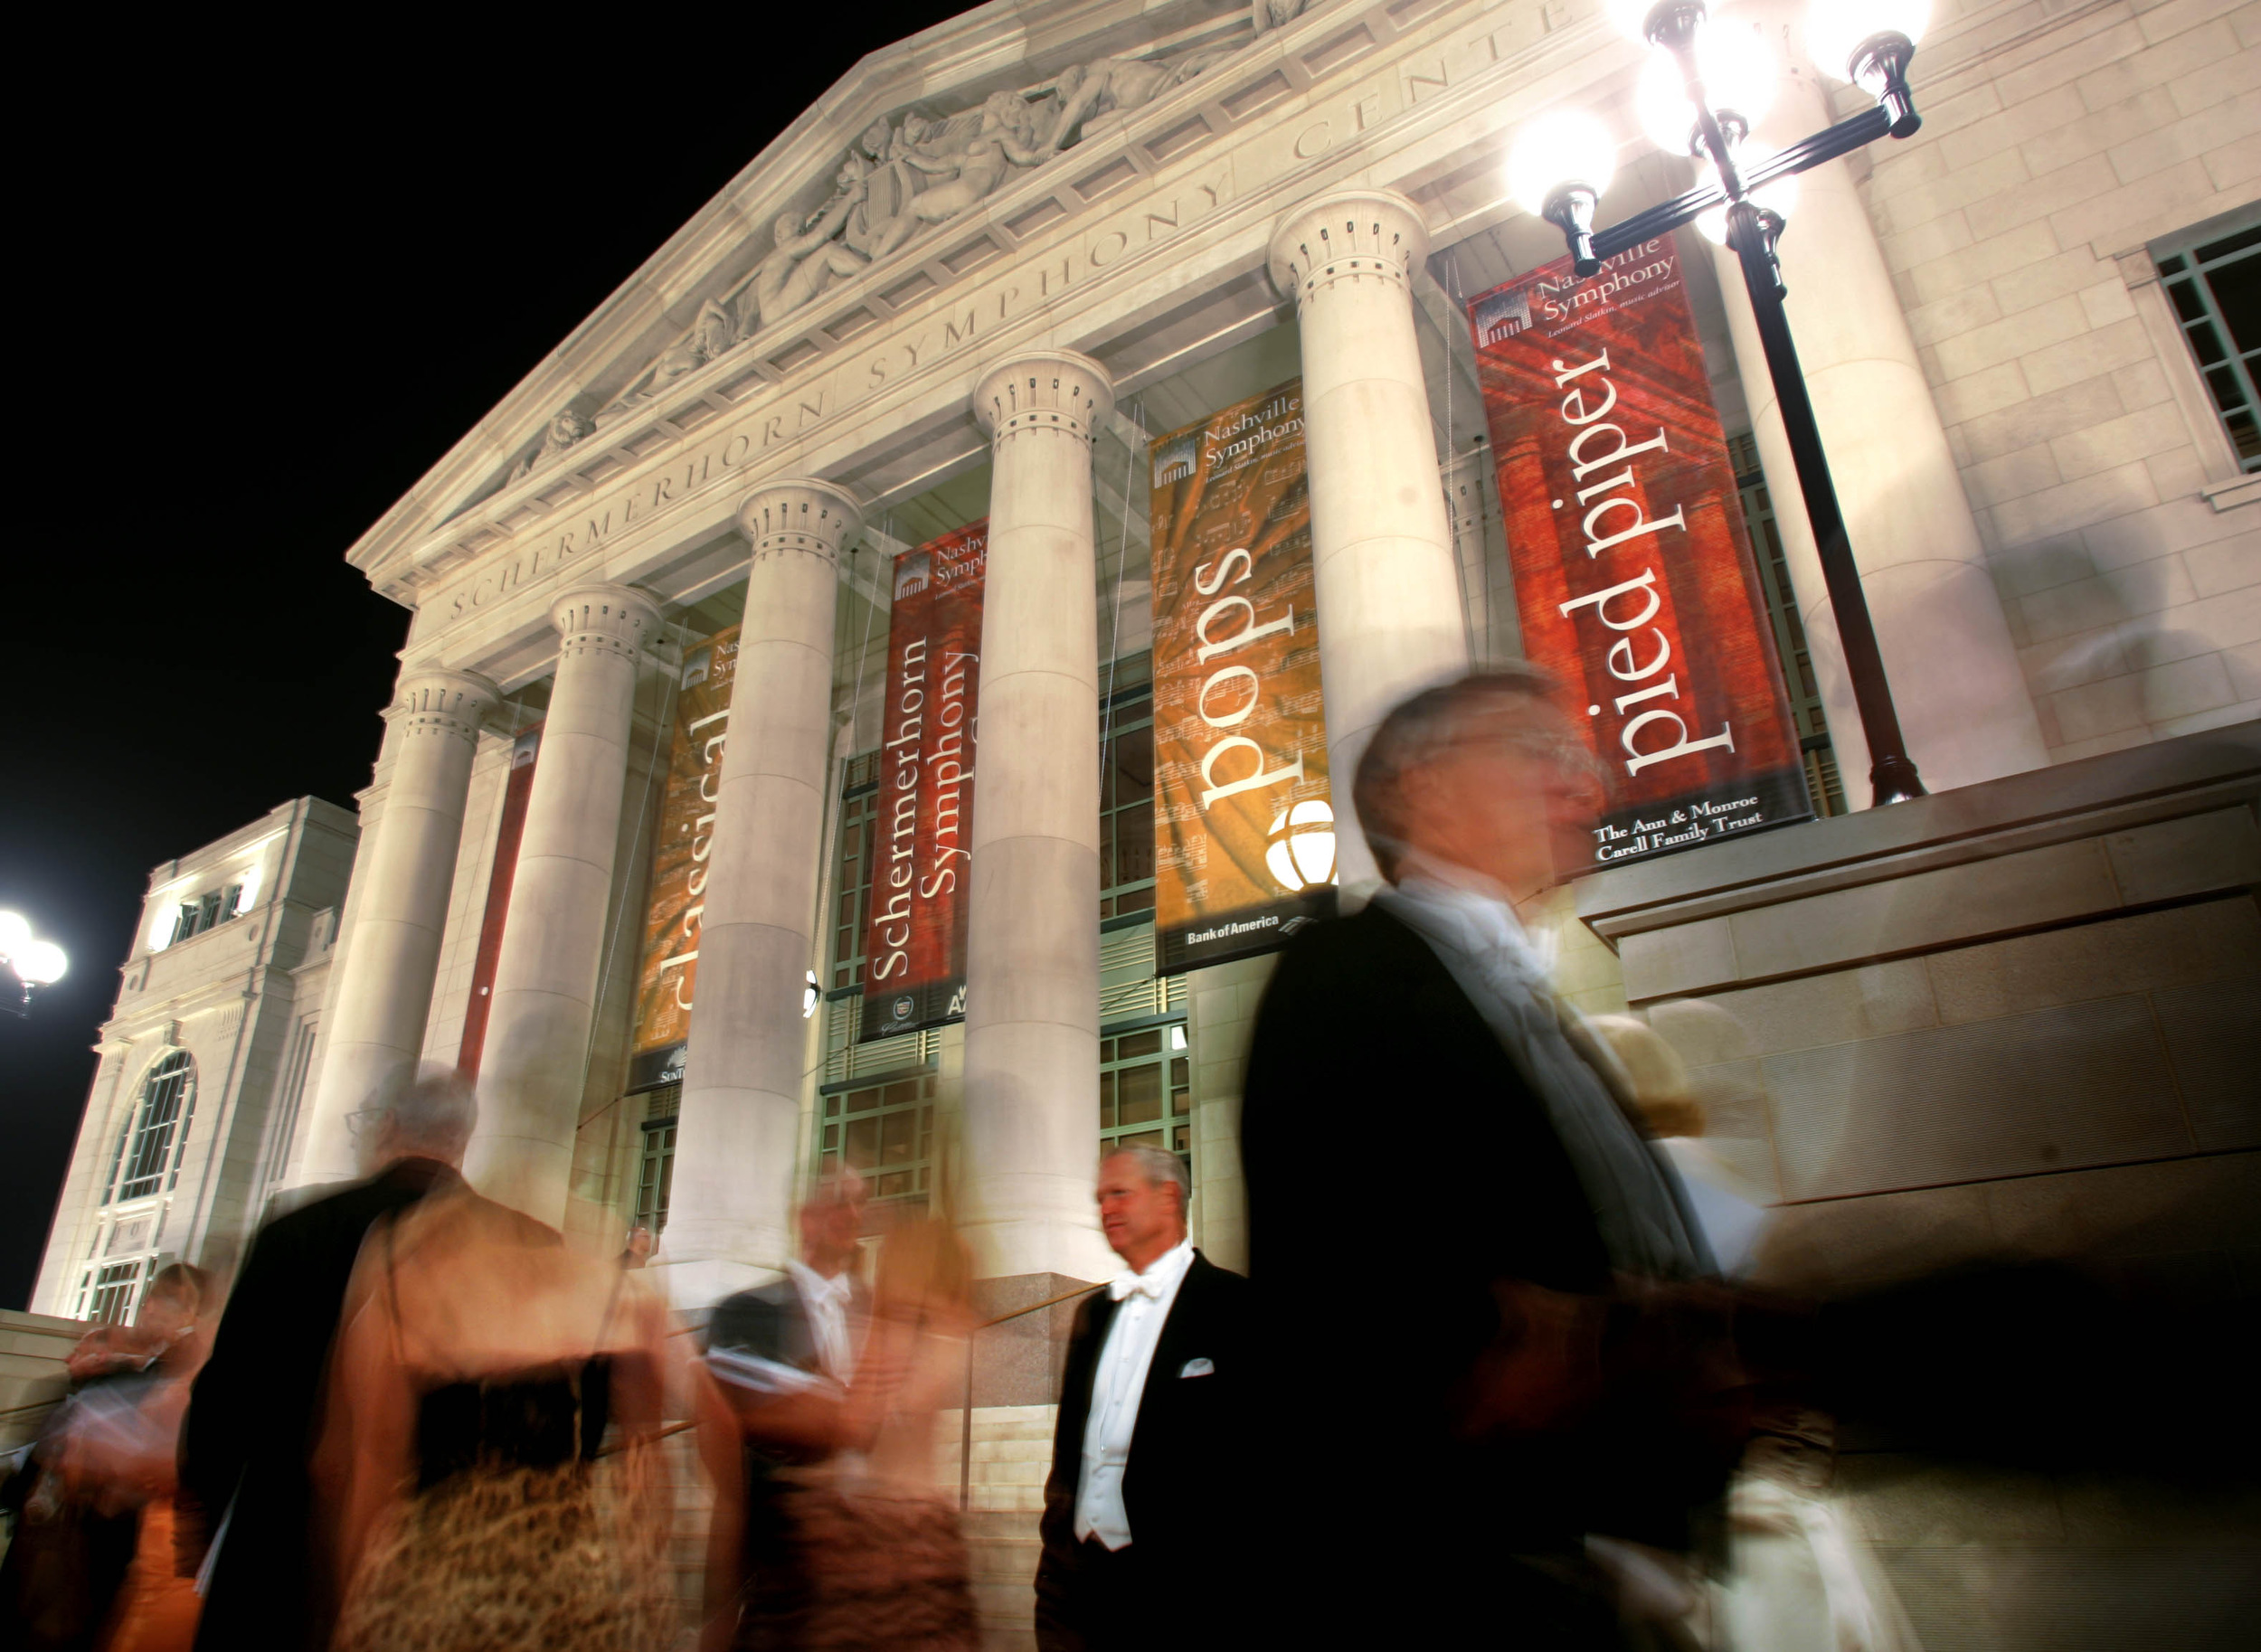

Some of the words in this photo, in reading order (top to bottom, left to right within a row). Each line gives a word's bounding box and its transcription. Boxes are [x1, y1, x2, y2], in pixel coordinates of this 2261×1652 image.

[1537, 239, 1660, 300] Naville
[1543, 254, 1675, 322] Symphony
[1547, 316, 1583, 339] Leonard
[450, 391, 825, 620] SCHERMERHORN
[868, 173, 1229, 390] SYMPHONY
[1204, 396, 1301, 447] Nashville
[1206, 417, 1305, 469] Symphony
[1551, 346, 1687, 560] piper
[1194, 547, 1305, 811] pops
[1556, 566, 1736, 778] pied
[920, 651, 979, 899] Symphony
[873, 635, 927, 981] Schermerhorn
[1593, 824, 1628, 844] The
[1631, 818, 1668, 835] Ann
[1670, 809, 1689, 825] &
[1689, 796, 1759, 819] Monroe
[1595, 835, 1649, 861] Carell
[1651, 823, 1709, 848] Family
[1712, 812, 1764, 833] Trust
[1187, 928, 1217, 946] Bank
[1217, 925, 1230, 939] of
[1230, 915, 1280, 936] America
